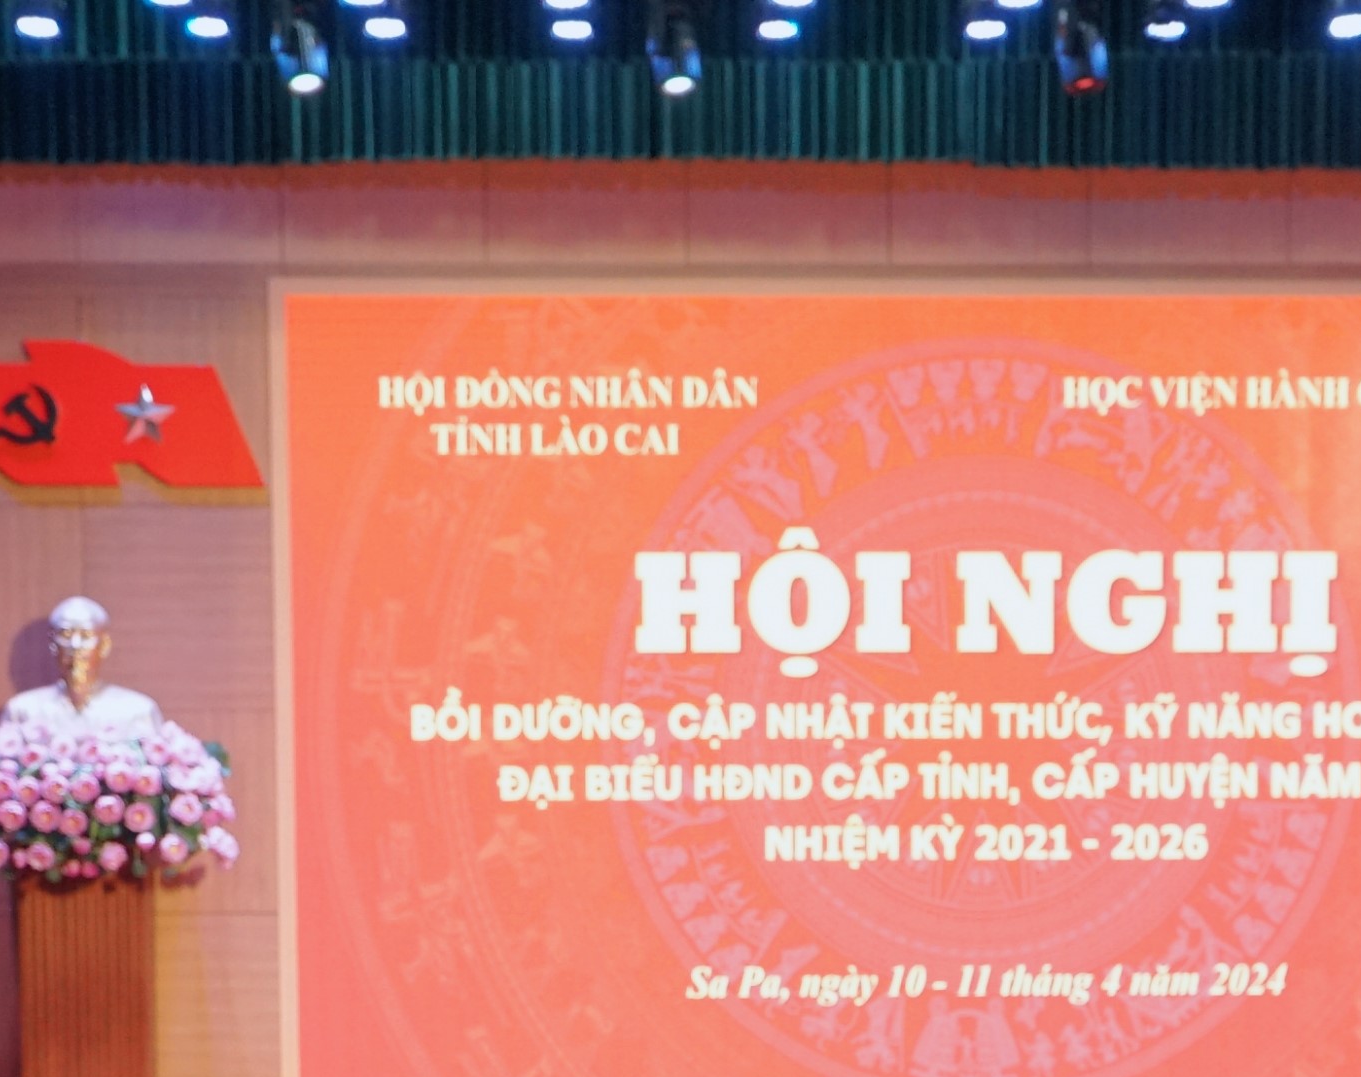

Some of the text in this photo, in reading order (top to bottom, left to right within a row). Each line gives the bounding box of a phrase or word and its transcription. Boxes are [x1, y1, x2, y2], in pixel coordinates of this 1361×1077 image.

[378, 367, 759, 416] HỘI ĐỒNG NHÂN DÂN
[1063, 376, 1142, 416] HỌC
[1150, 372, 1237, 416] VIỆN
[1246, 368, 1350, 410] HÀNH
[430, 414, 680, 456] TỈNH LÀO CAI
[635, 526, 1338, 678] HỘI NGHỊ
[410, 686, 481, 742] BỒI
[494, 694, 655, 747] DƯỠNG,
[667, 693, 756, 749] CẬP
[766, 693, 875, 749] NHẬT
[883, 691, 983, 740] KIẾN
[991, 691, 1112, 746] THỨC,
[1125, 692, 1178, 739] KỸ
[1188, 692, 1302, 739] NĂNG
[497, 764, 574, 810] ĐẠI
[585, 754, 682, 801] BIỂU
[693, 764, 813, 801] HĐND
[821, 748, 910, 800] CẤP
[917, 751, 1020, 806] TỈNH,
[1032, 748, 1120, 800] CẤP
[1130, 752, 1259, 809] HUYỆN
[764, 813, 1209, 870] NHIỆM KỲ 2021 - 2026
[686, 965, 728, 1000] Sa
[740, 966, 790, 1005] Pa,
[799, 964, 878, 1007] ngày
[887, 965, 925, 997] 10
[957, 965, 989, 997] 11
[1000, 964, 1094, 1005] tháng
[1101, 964, 1121, 997] 4
[1129, 964, 1200, 997] năm
[1212, 962, 1289, 997] 2024
